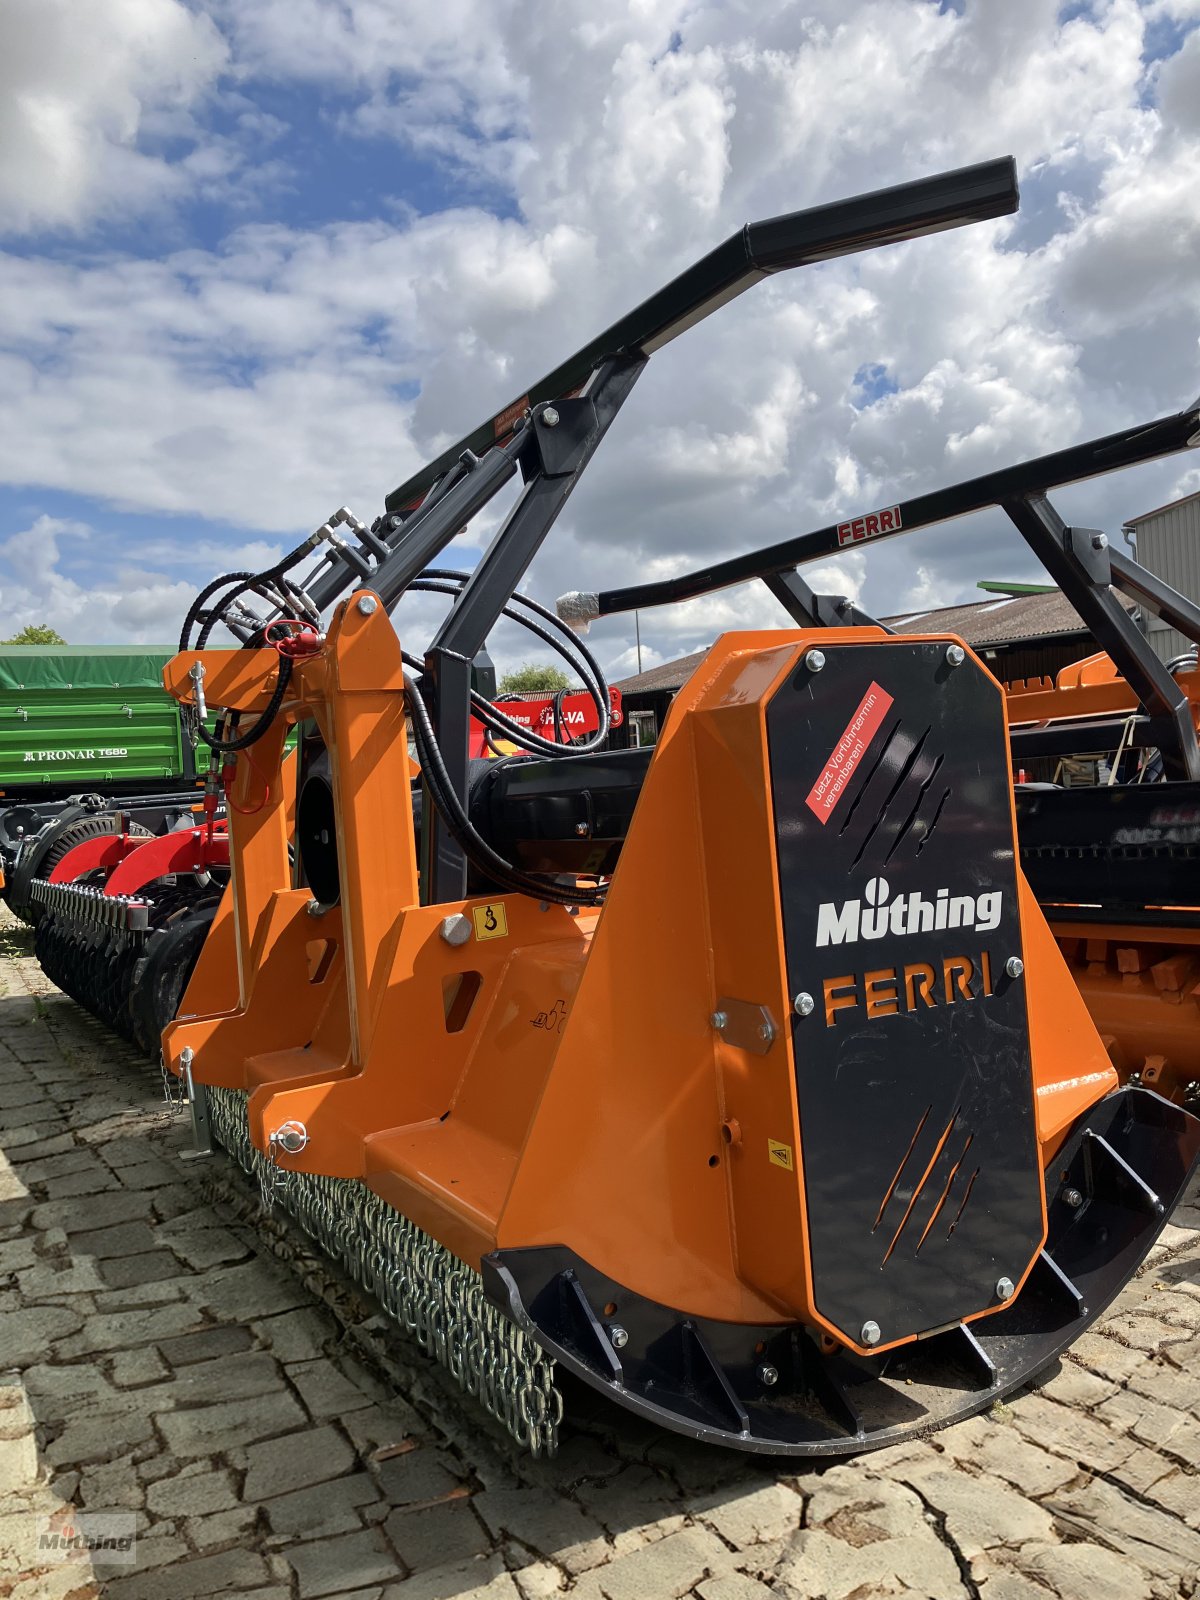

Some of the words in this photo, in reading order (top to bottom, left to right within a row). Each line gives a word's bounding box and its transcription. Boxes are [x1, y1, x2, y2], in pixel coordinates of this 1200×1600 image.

[838, 507, 901, 545] FERRI
[37, 749, 96, 761] PRONAR
[98, 748, 128, 757] T680
[814, 770, 834, 801] Jetzt
[828, 694, 877, 770] Vorführtermin
[823, 740, 865, 809] vereinbaren!
[815, 876, 1004, 948] Müthing
[822, 950, 995, 1028] FERRI
